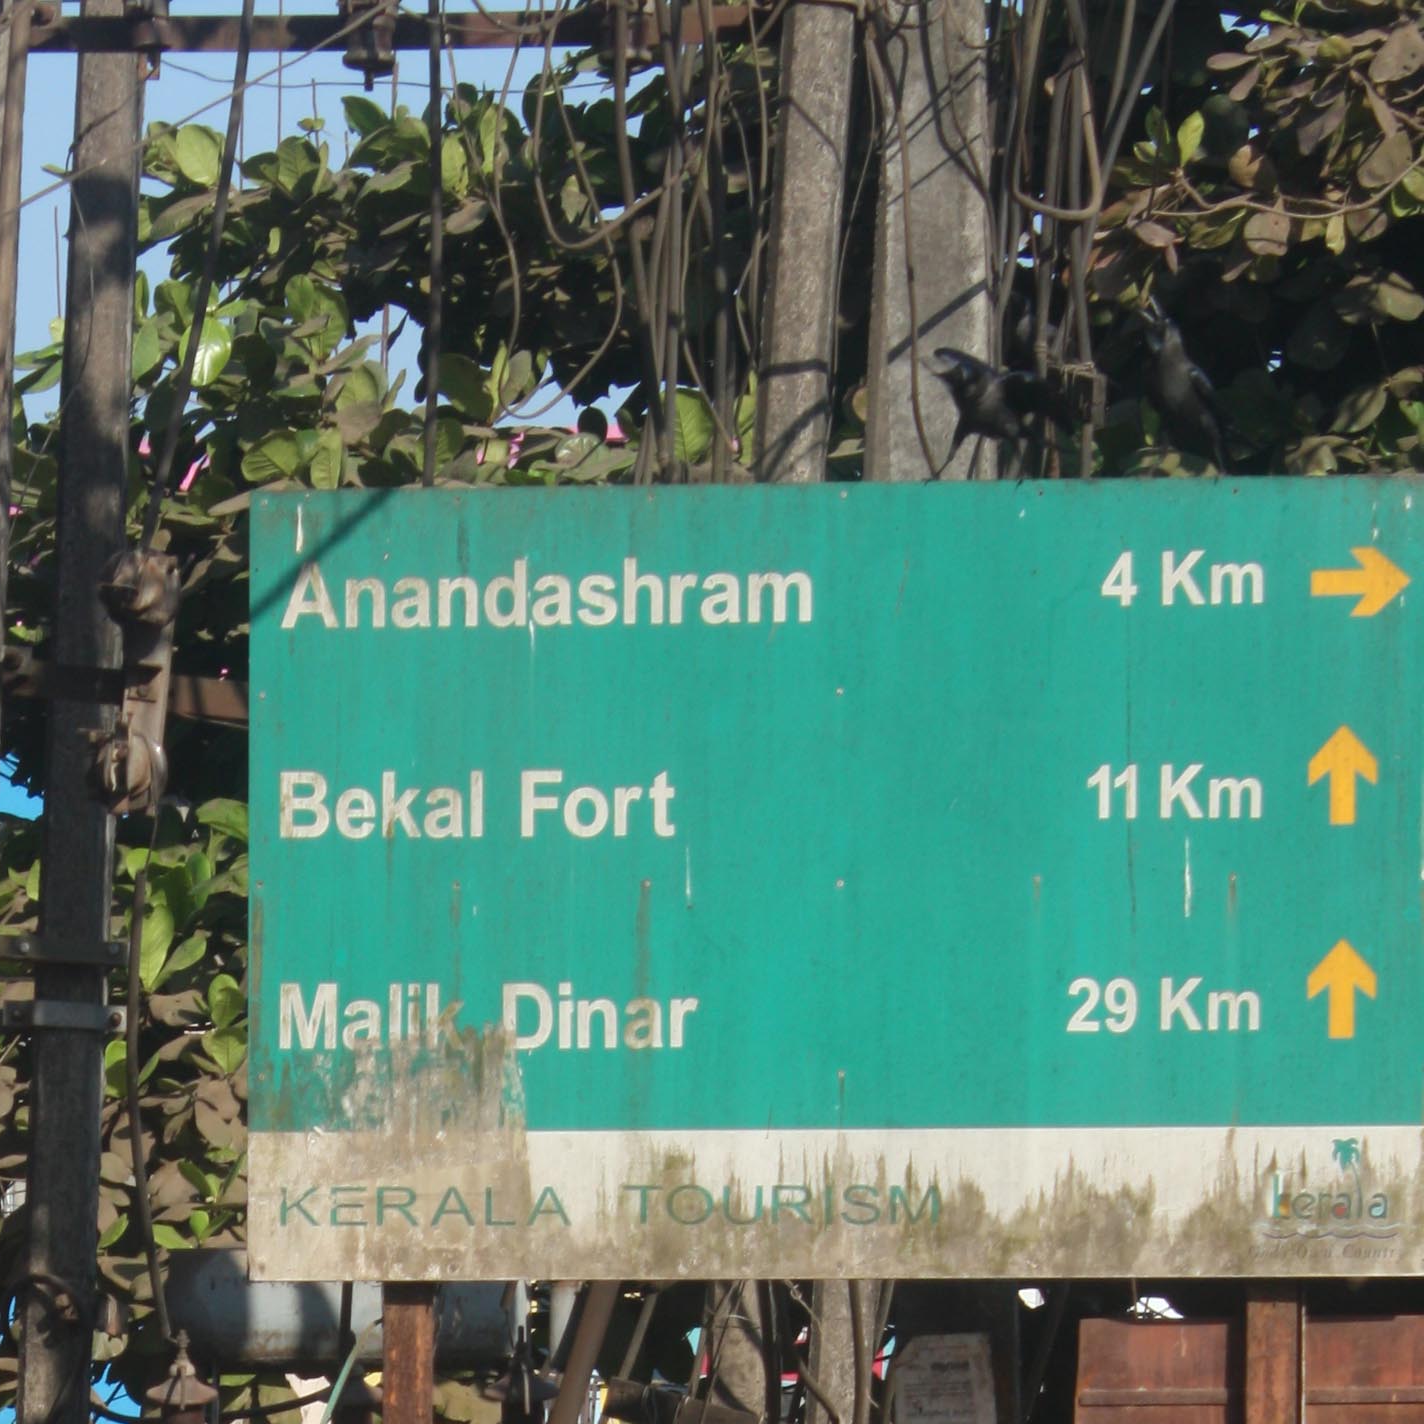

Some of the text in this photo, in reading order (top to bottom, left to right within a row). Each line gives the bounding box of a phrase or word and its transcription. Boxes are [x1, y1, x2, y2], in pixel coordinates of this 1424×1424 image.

[280, 549, 1265, 629] Anandashram 4 Km
[279, 763, 1264, 841] Bekal Fort 11 Km
[278, 976, 1262, 1051] Malik Dinar 29 Km
[277, 1183, 941, 1228] KERALA TOURISM
